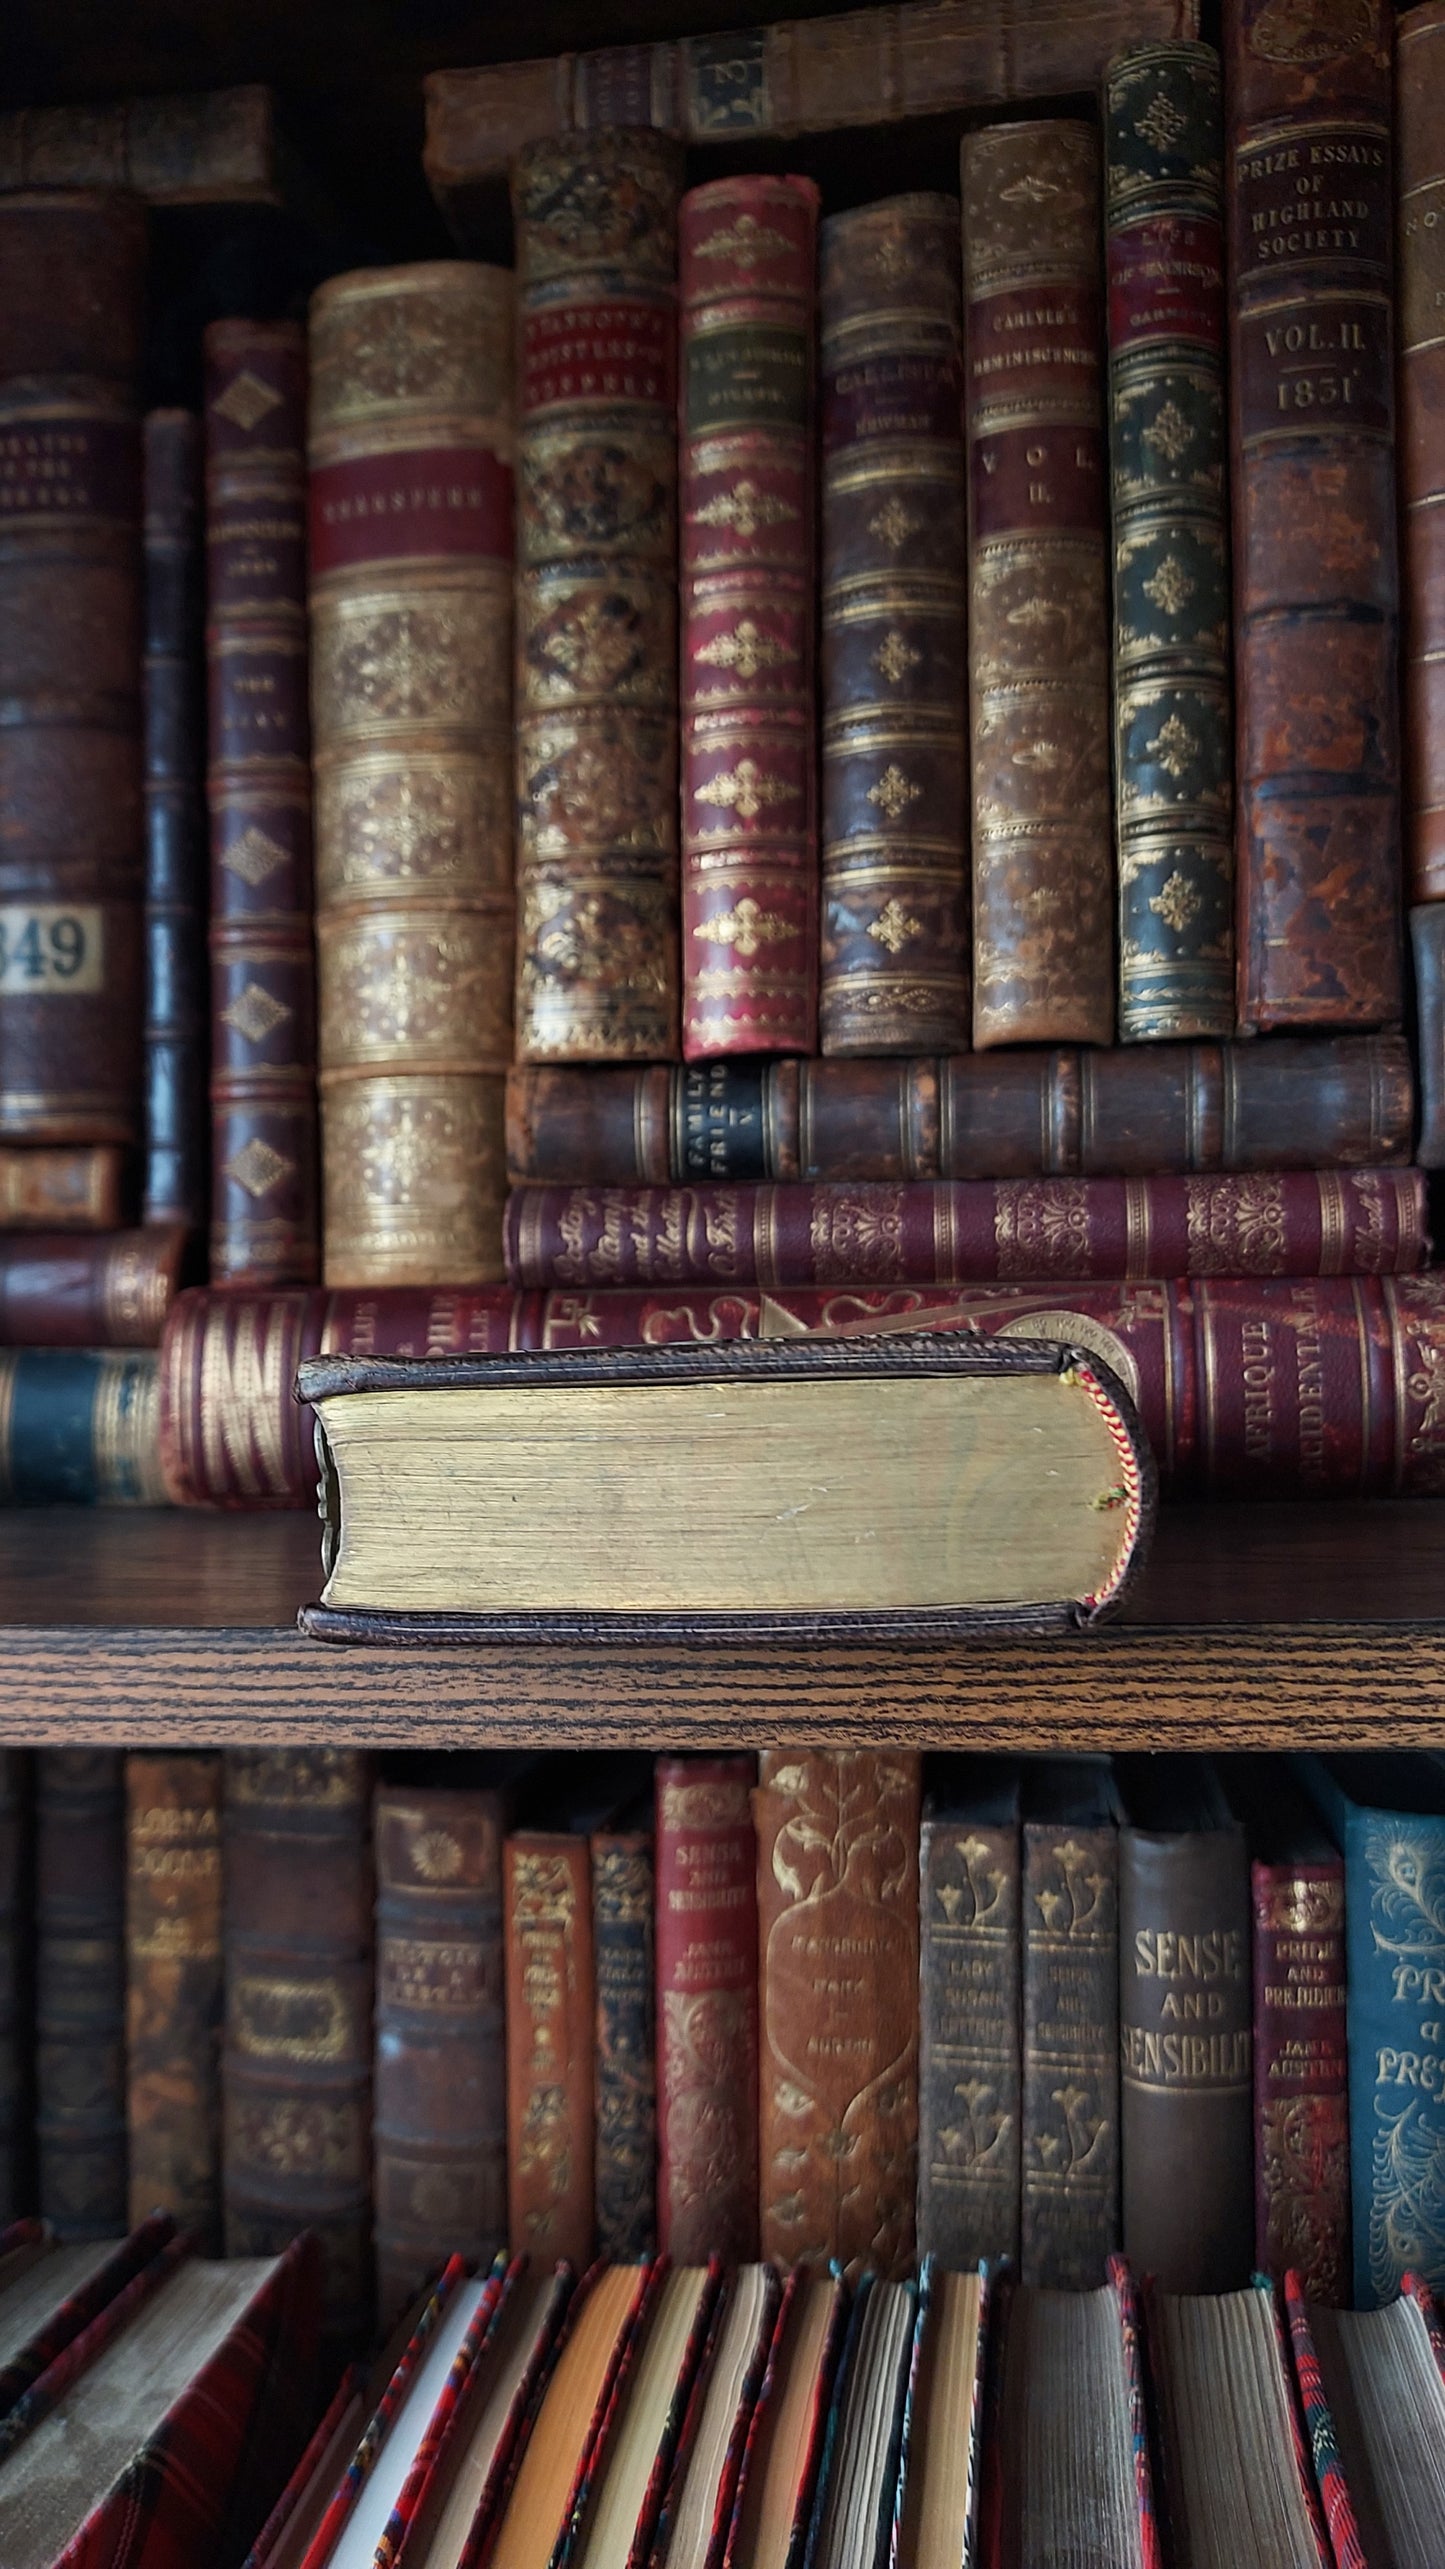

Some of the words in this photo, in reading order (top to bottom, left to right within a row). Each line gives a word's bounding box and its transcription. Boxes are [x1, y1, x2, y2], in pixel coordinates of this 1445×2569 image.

[1236, 146, 1300, 185] PRIZE
[1309, 143, 1384, 168] ESSAYS
[1296, 174, 1324, 195] OF
[1251, 199, 1369, 233] HIGHLAND
[1257, 228, 1360, 259] SOCIETY
[0, 916, 87, 979] 49
[687, 1070, 705, 1167] FAMILY
[708, 1064, 728, 1174] FRIEND
[1241, 1321, 1275, 1463] AFRIQUE
[1289, 1286, 1324, 1487] CCIDENTALE
[1134, 1928, 1240, 1982] SENSE
[1275, 1940, 1335, 1961] PRIDE
[1287, 1966, 1325, 1983] AND
[1391, 1964, 1445, 2003] PR
[1160, 1991, 1224, 2020] AND
[1122, 2024, 1248, 2080] SENSIBILIT
[1278, 2040, 1332, 2056] JANE
[1268, 2058, 1345, 2079] AUSTEN
